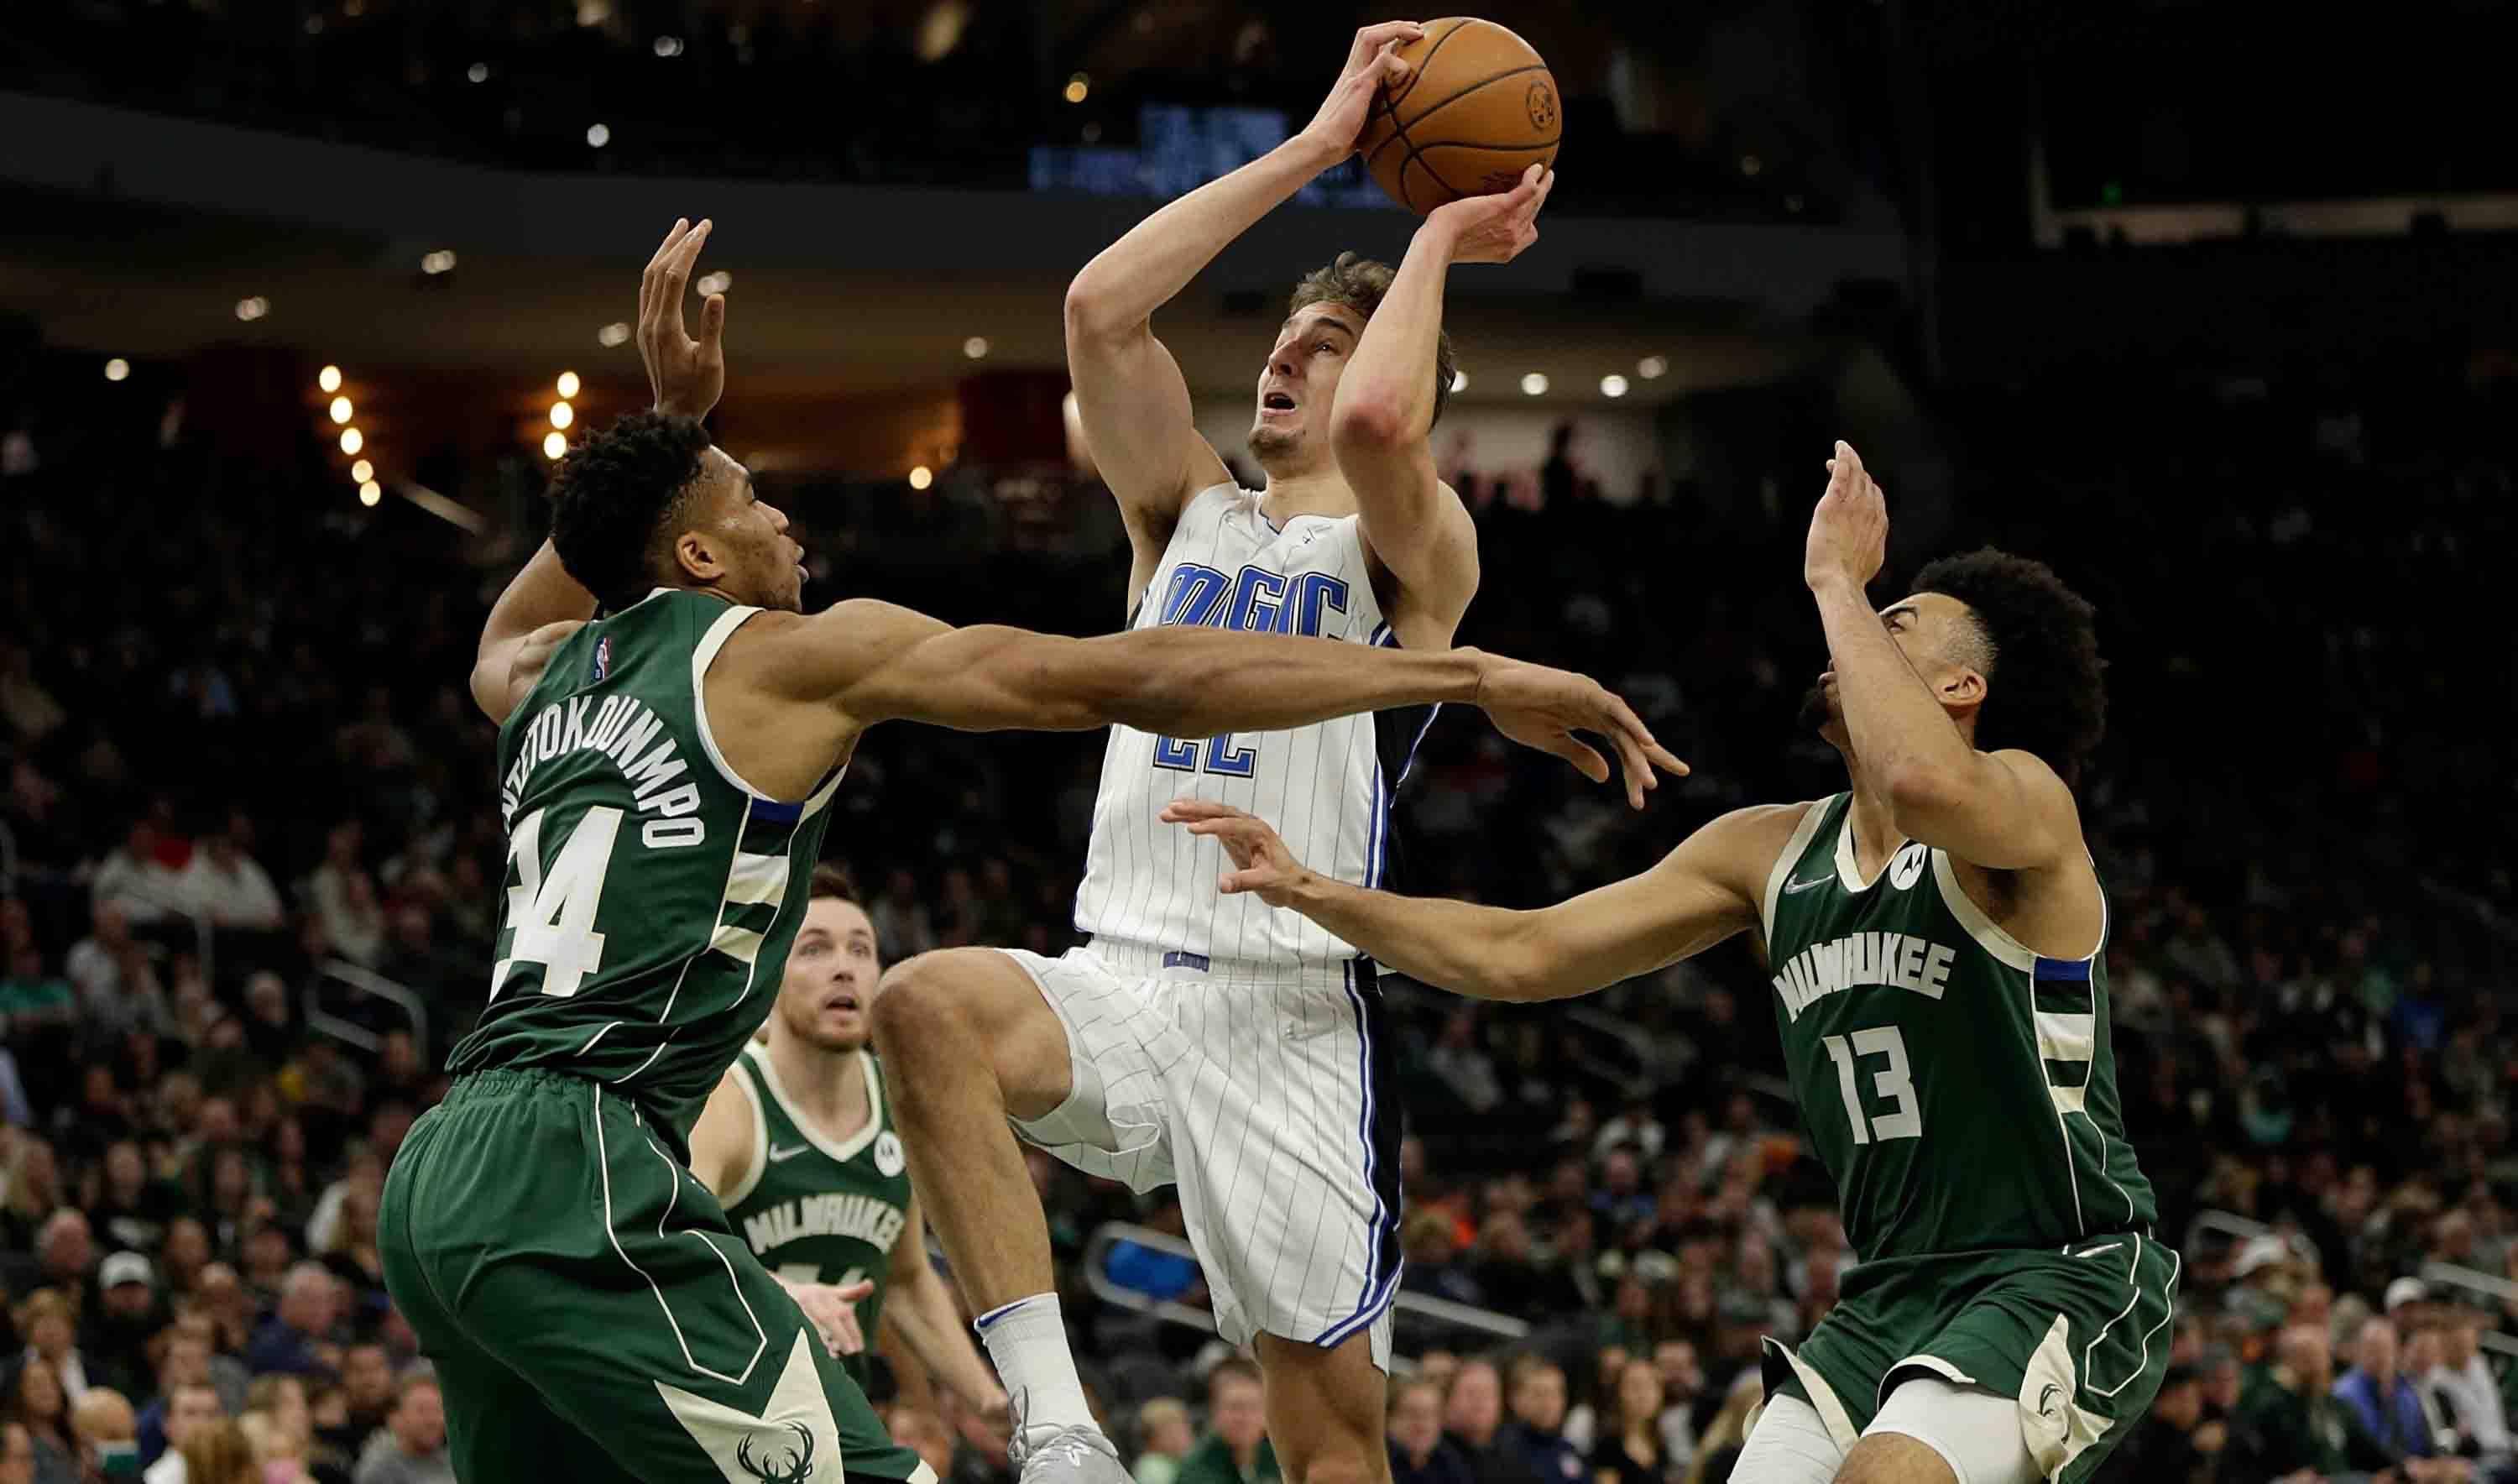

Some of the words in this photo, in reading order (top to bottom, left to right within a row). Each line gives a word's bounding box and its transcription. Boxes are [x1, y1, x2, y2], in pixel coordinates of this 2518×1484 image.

[1162, 562, 1349, 640] MGIC
[501, 695, 705, 849] NTETOKOUNMPO
[1821, 1027, 1922, 1144] 13
